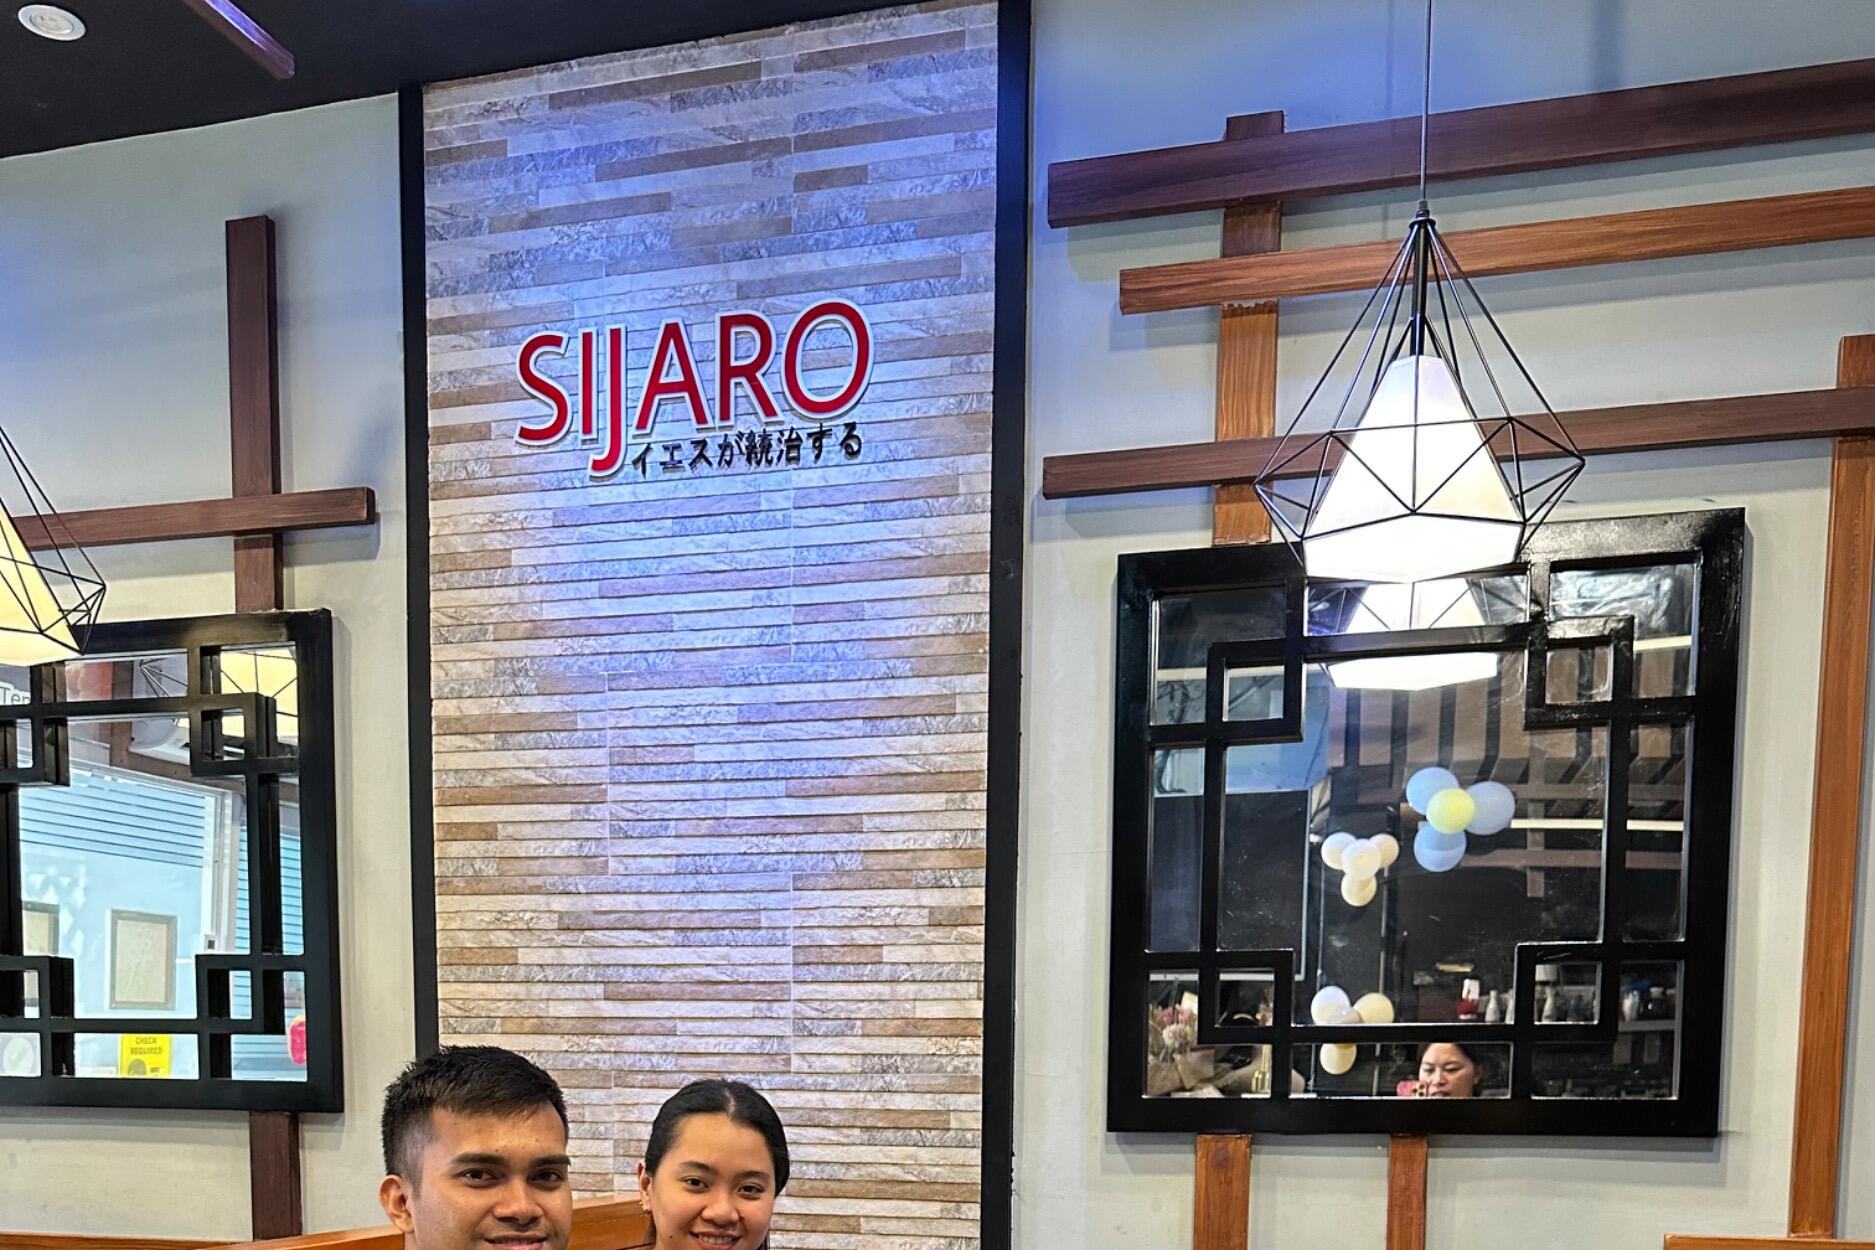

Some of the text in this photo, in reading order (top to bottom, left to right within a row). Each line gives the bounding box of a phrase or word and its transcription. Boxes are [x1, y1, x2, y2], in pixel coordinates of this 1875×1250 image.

[515, 299, 873, 477] SIJARO
[632, 422, 863, 479] イエスが統治する
